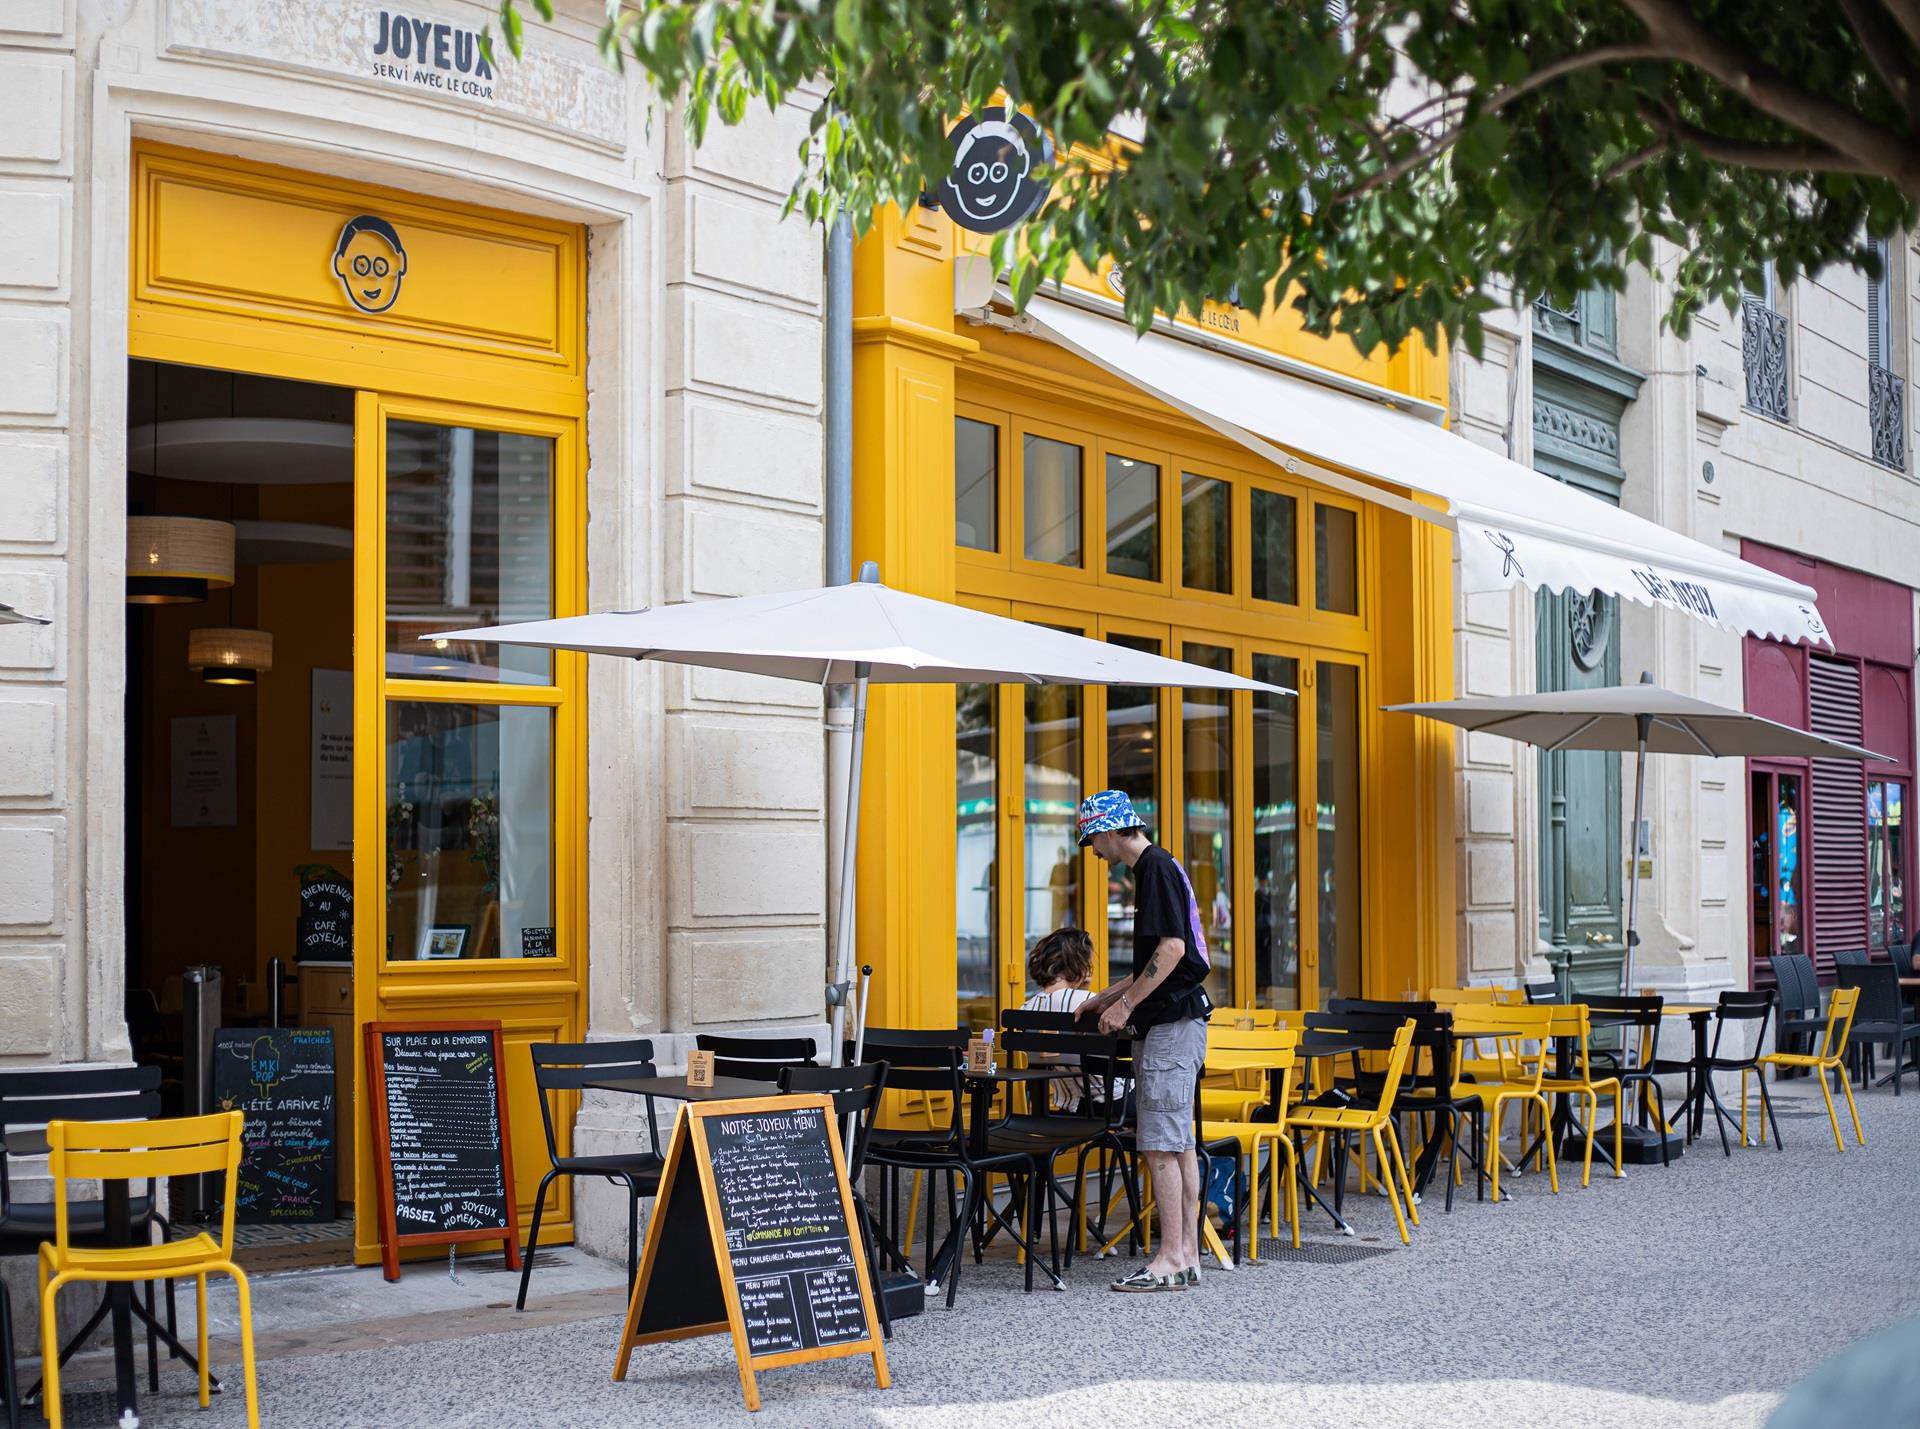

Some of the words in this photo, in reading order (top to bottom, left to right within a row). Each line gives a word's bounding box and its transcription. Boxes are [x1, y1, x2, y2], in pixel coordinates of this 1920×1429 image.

[373, 11, 493, 80] JOYEUX
[413, 71, 442, 88] AVEC
[447, 77, 459, 92] LE
[462, 82, 493, 100] CŒUR
[301, 883, 353, 903] BIENVENUE
[319, 901, 331, 911] AU
[314, 920, 337, 931] CAFÉ
[304, 932, 348, 948] JOYEUX
[386, 1036, 401, 1047] SUR
[405, 1036, 428, 1046] PLACE
[443, 1037, 450, 1045] A
[452, 1035, 488, 1045] EMPORTER
[384, 1062, 395, 1071] Nos
[255, 1071, 274, 1082] POP
[721, 1119, 754, 1136] NOTRE
[756, 1116, 792, 1133] JOYEUX
[794, 1116, 817, 1131] MENU
[270, 1128, 314, 1139] disponible
[286, 1154, 322, 1166] CHOCOLAT
[281, 1195, 311, 1205] FRAISE
[396, 1204, 436, 1223] PASSEZ
[440, 1201, 453, 1215] UN
[461, 1200, 498, 1218] JOYEUX
[443, 1213, 484, 1230] MOMENT
[751, 1228, 783, 1241] COMMANDE
[783, 1227, 792, 1237] AU
[732, 1258, 748, 1267] MENU
[745, 1282, 760, 1290] MENU
